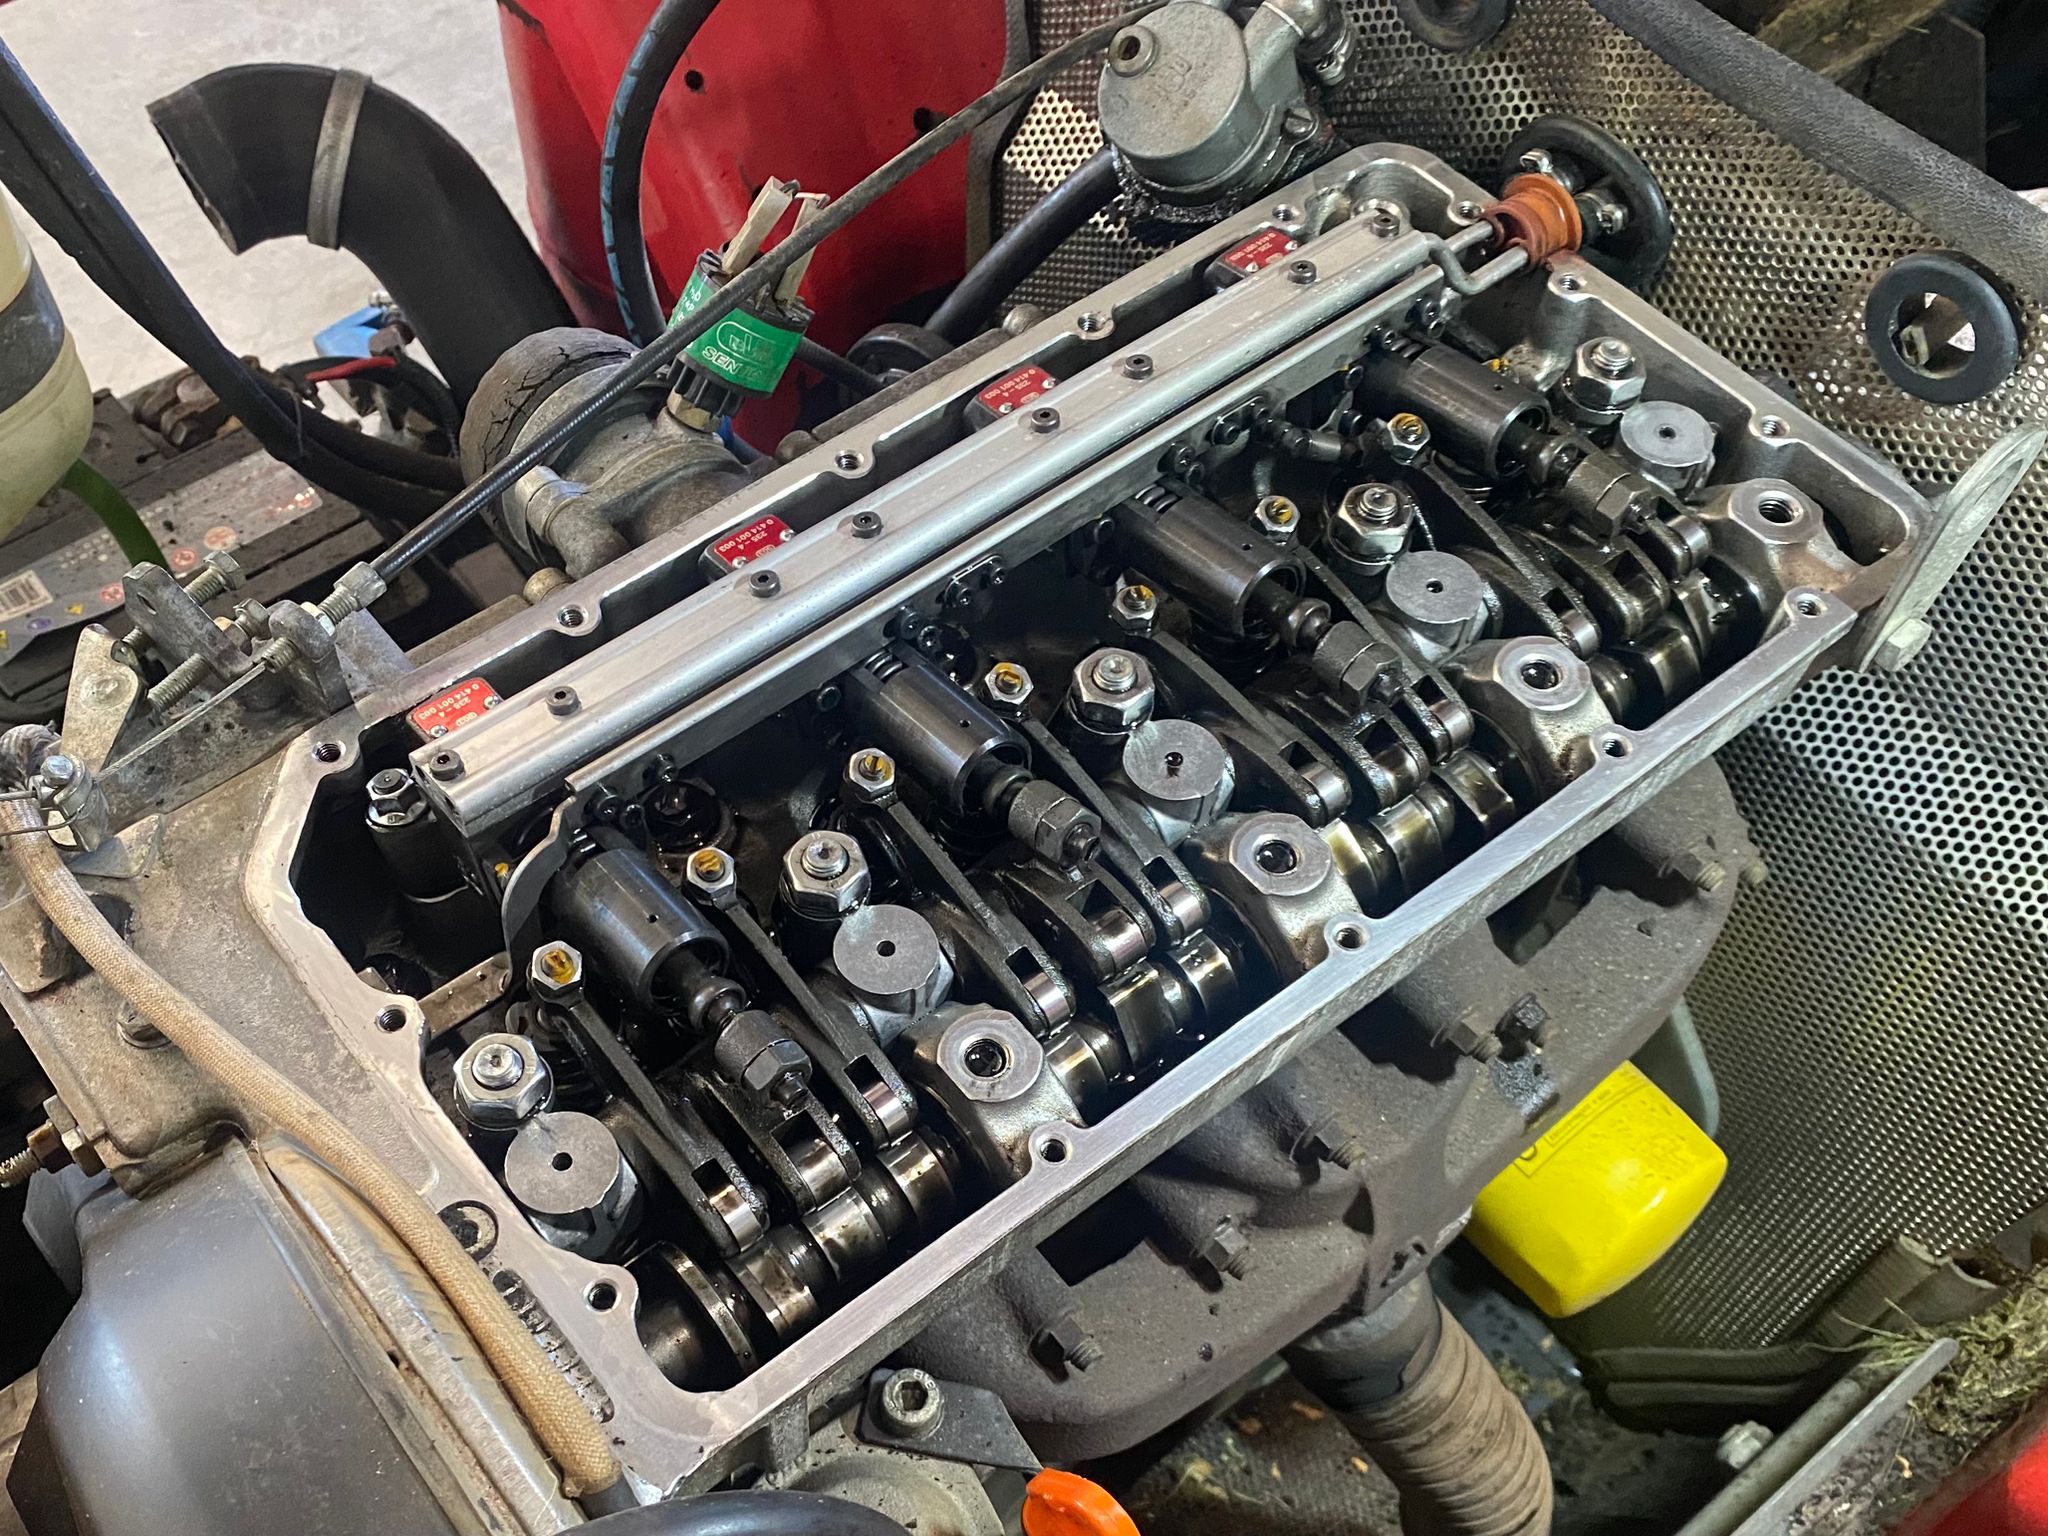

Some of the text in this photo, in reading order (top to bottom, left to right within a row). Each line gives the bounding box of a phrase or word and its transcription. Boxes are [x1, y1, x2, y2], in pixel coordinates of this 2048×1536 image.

[1014, 372, 1029, 383] 414
[750, 523, 767, 534] 414
[735, 532, 752, 543] 001
[750, 530, 768, 542] 235
[718, 541, 736, 552] 003
[454, 687, 472, 699] 414
[437, 697, 454, 709] 001
[418, 706, 437, 720] 003
